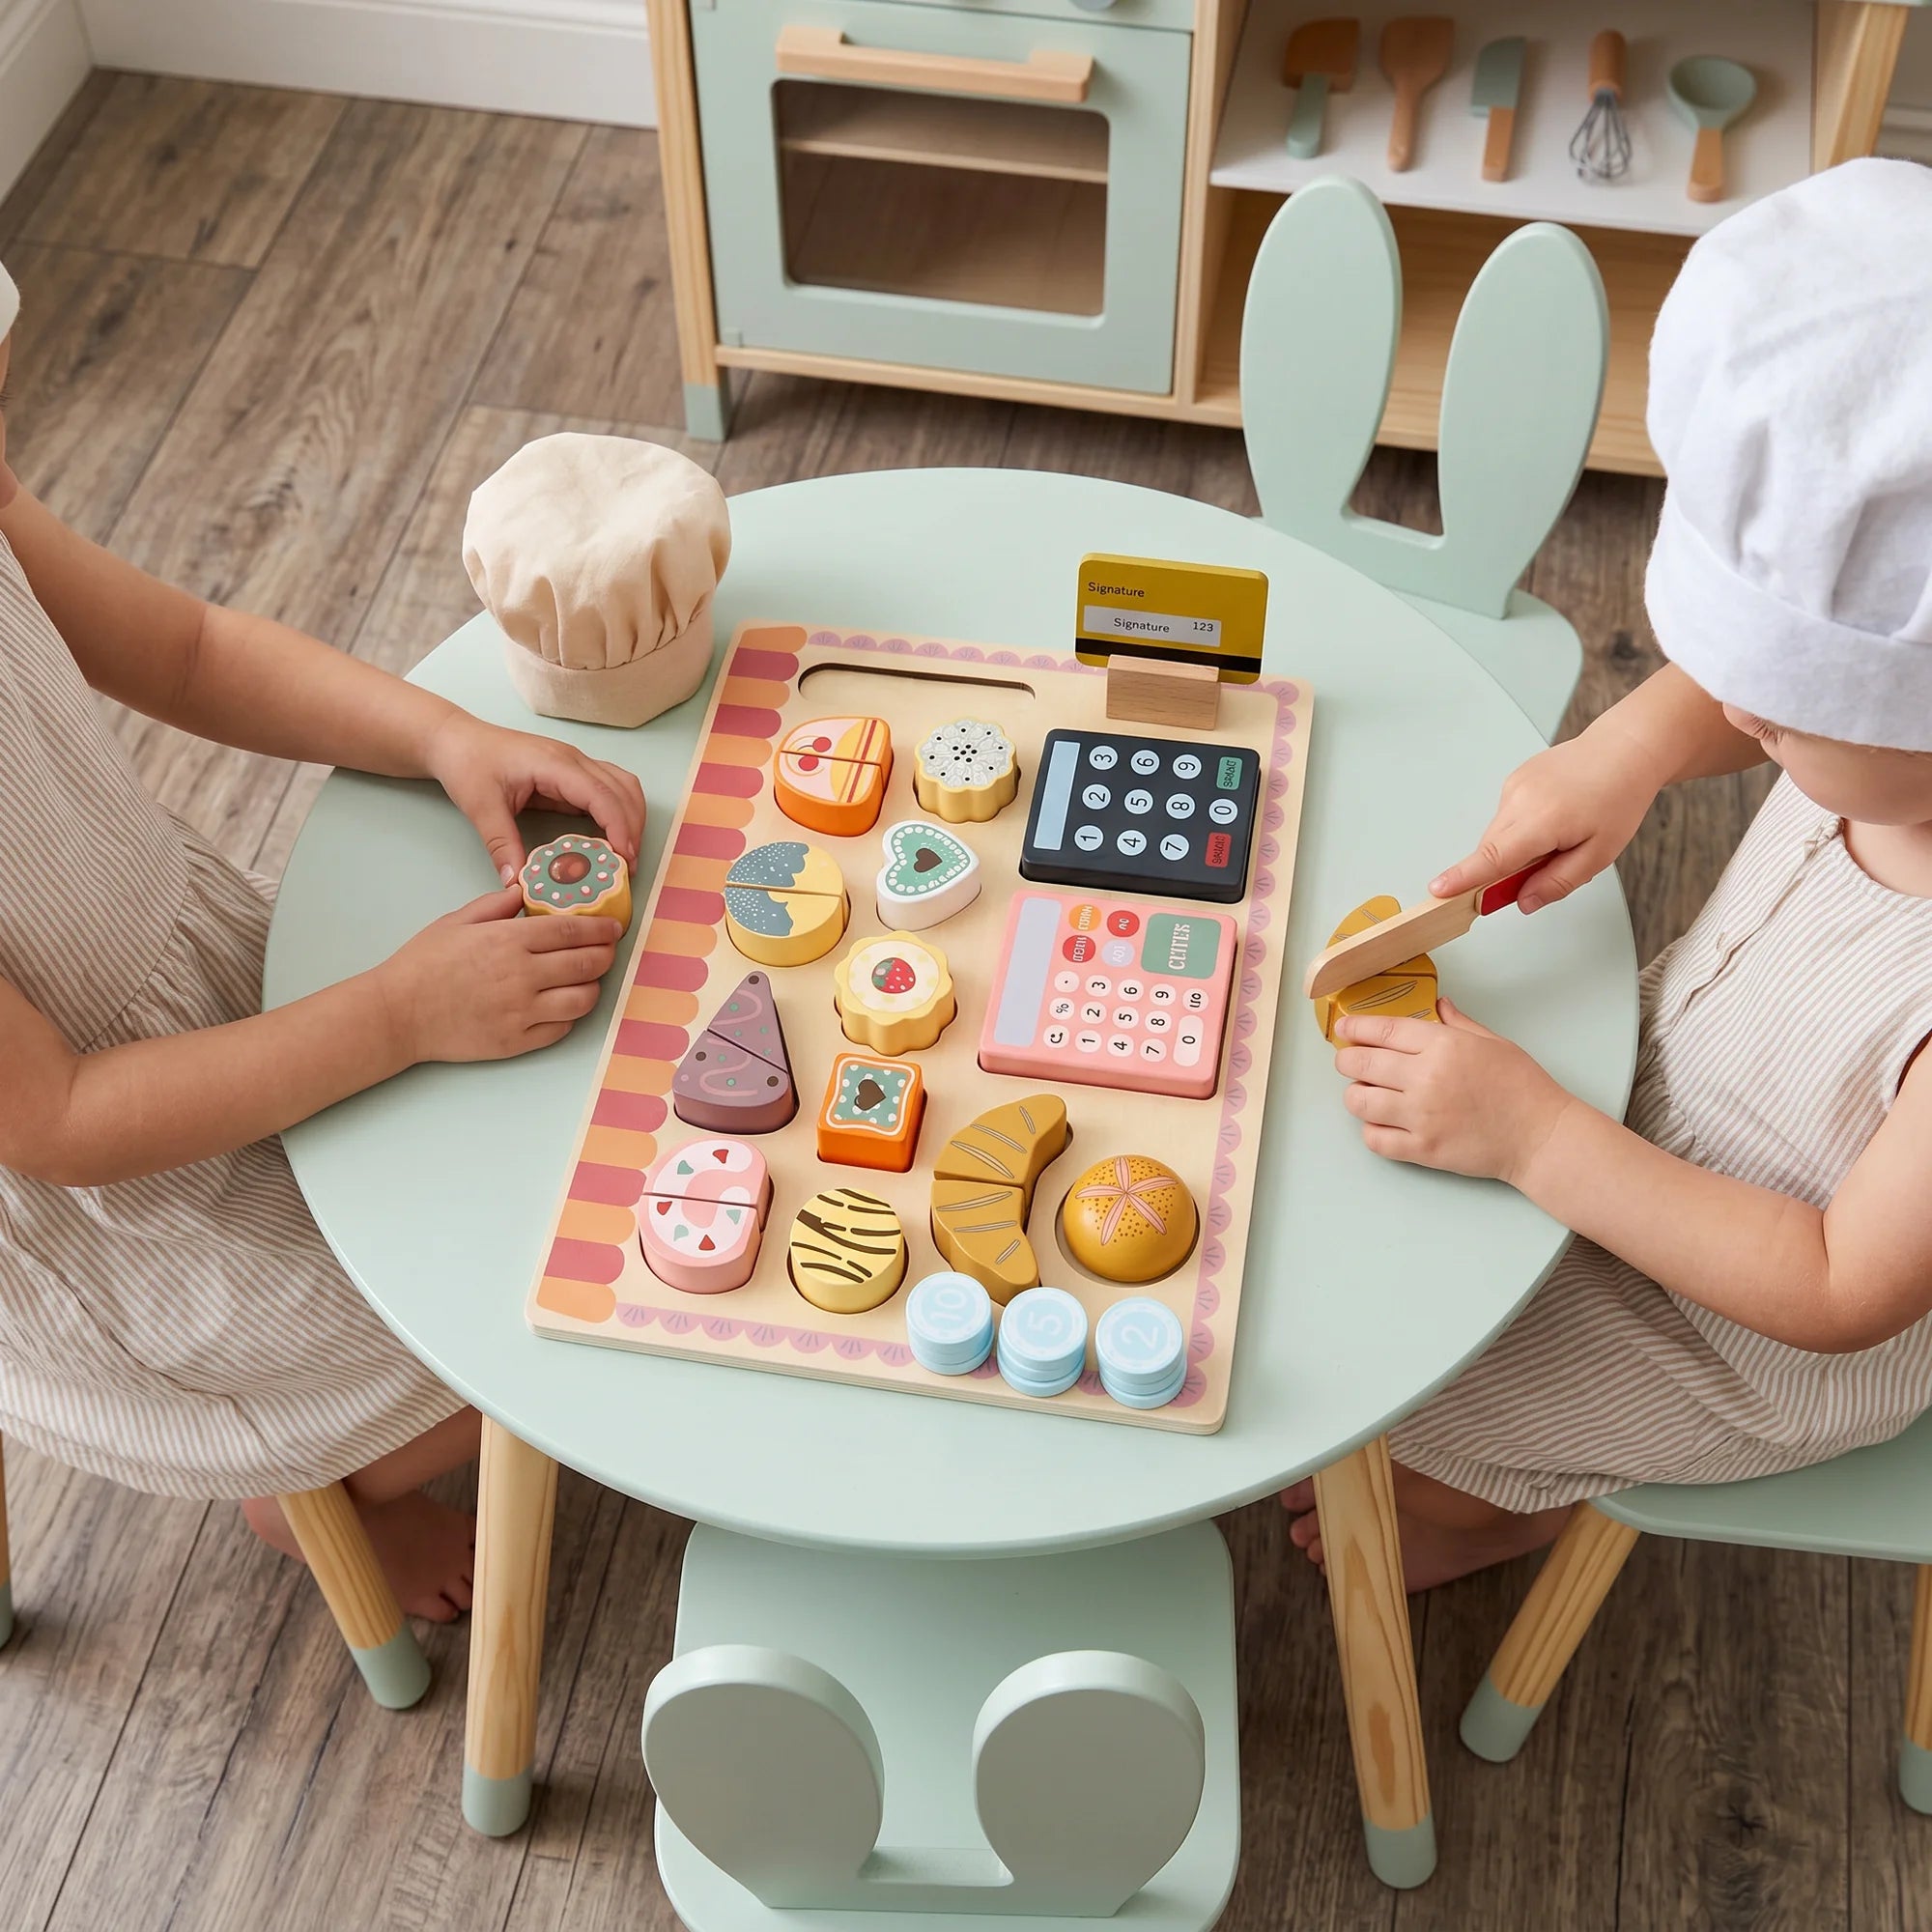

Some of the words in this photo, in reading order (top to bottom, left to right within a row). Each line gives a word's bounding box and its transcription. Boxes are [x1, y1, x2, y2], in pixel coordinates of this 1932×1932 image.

[1088, 582, 1145, 598] Signature
[1114, 617, 1170, 633] Signature
[1193, 621, 1214, 632] 123
[1094, 753, 1113, 763] 3
[1136, 757, 1155, 767] 6
[1178, 761, 1196, 772] 9
[1088, 791, 1106, 803] 2
[1129, 797, 1148, 808] 5
[1171, 801, 1190, 811] 8
[1213, 805, 1233, 816] 0
[1122, 837, 1142, 848] 4
[1164, 840, 1182, 852] 7
[930, 1288, 966, 1321] 10
[1028, 1311, 1063, 1336] 5
[1122, 1324, 1158, 1349] 2
